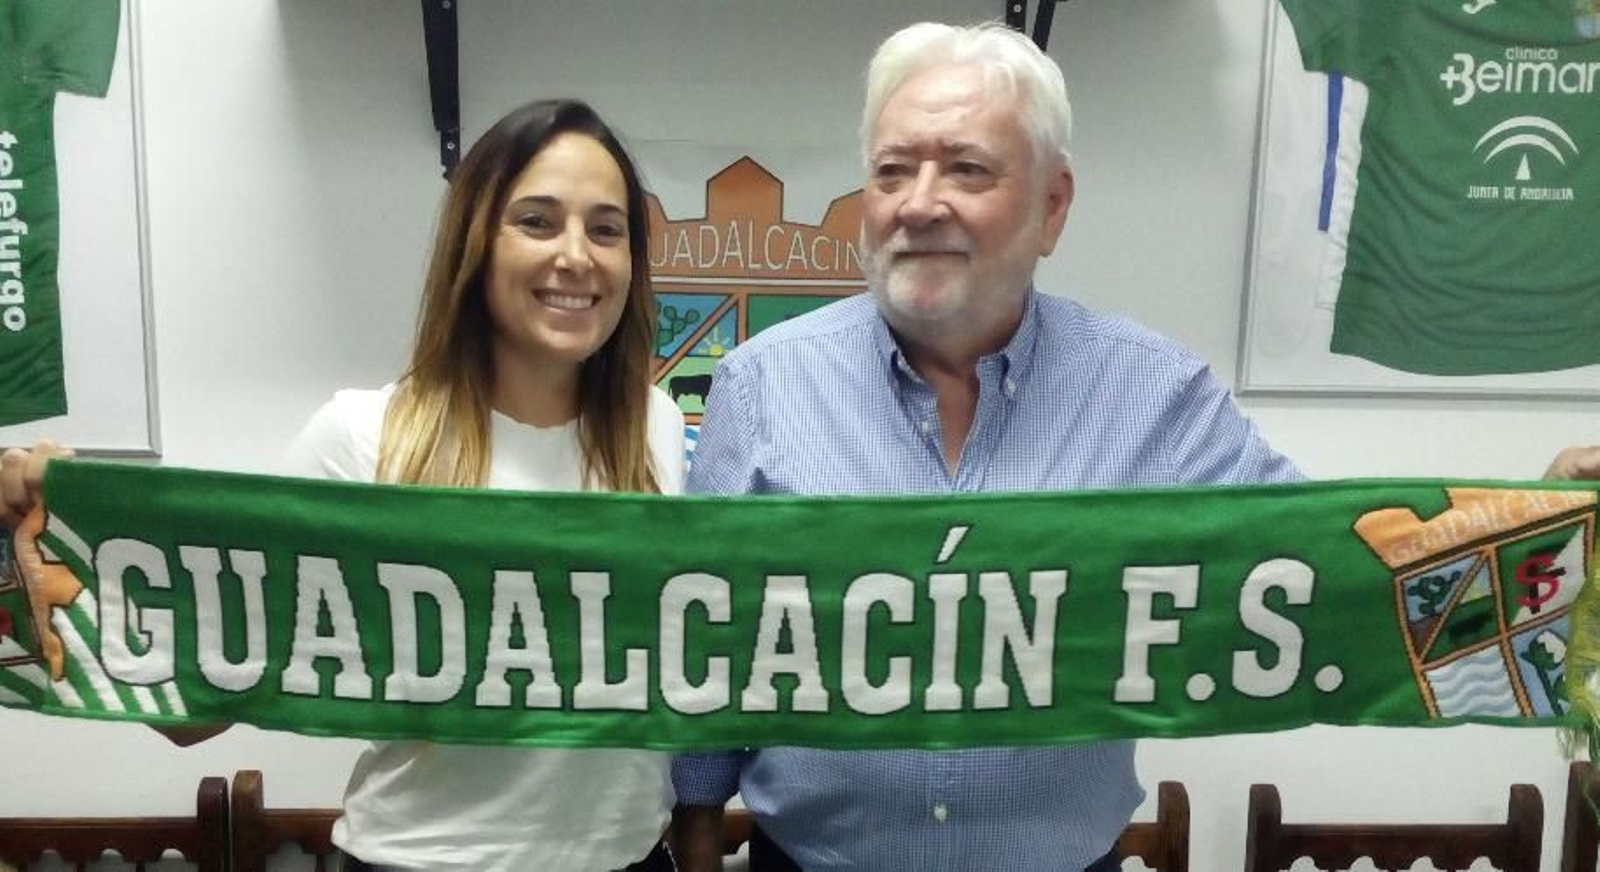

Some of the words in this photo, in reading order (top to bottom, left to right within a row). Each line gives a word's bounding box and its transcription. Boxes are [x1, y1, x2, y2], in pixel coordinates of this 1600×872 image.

[1467, 185, 1499, 200] JUNTA
[1504, 186, 1516, 201] DE
[650, 219, 864, 272] UADALCACIN
[94, 527, 1067, 715] GUADALCACÍN
[1114, 558, 1343, 702] F.S.
